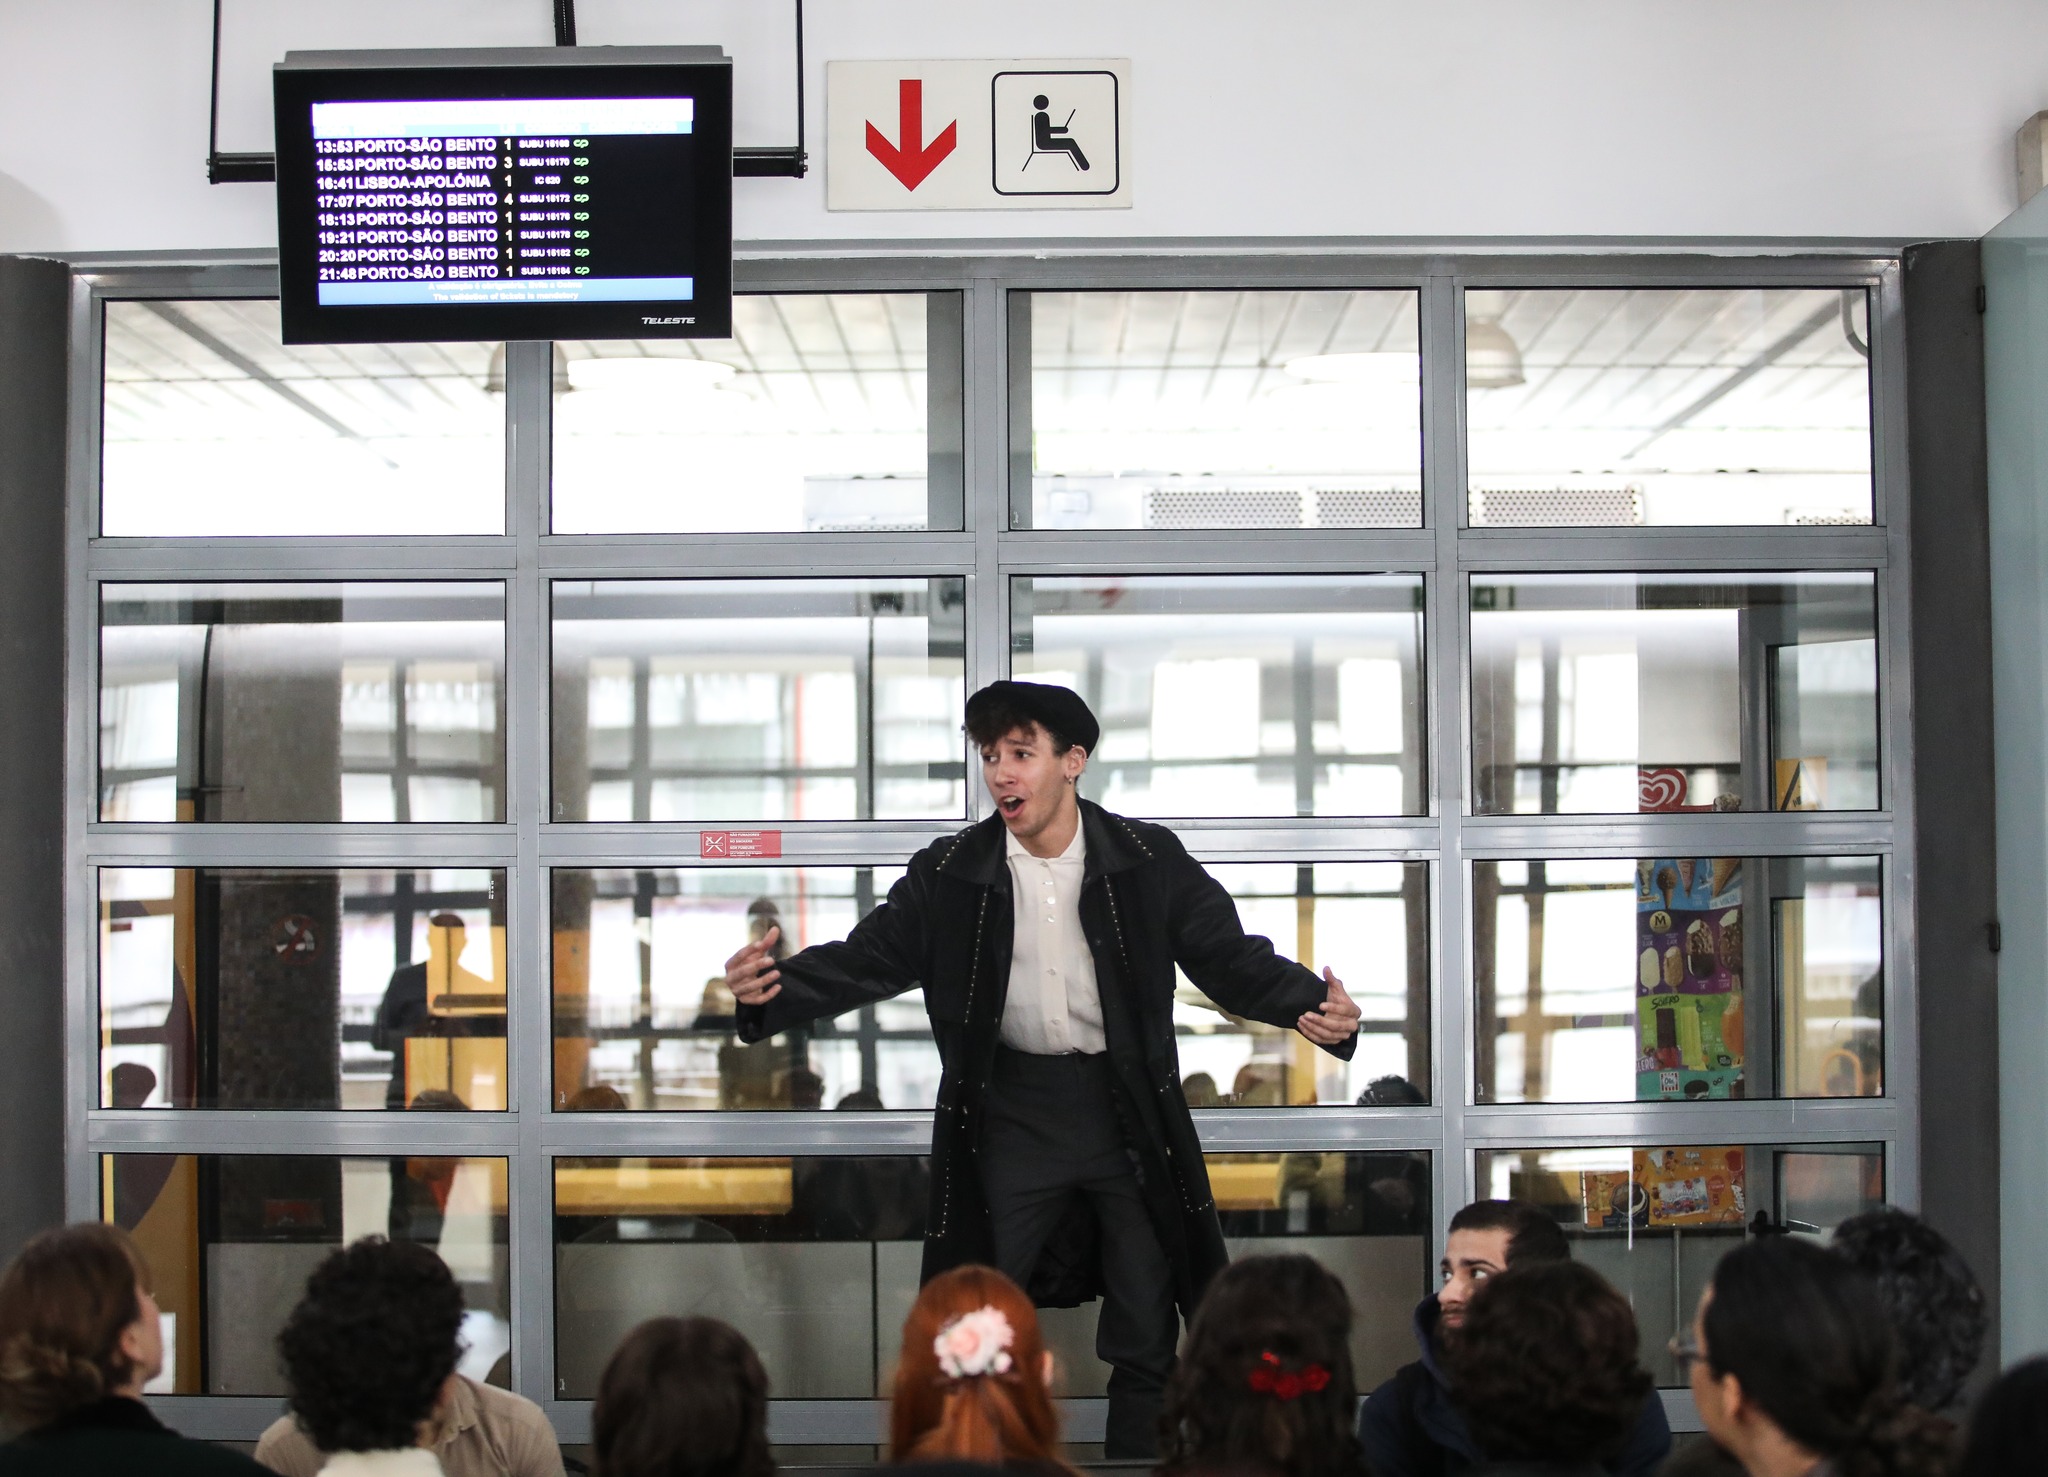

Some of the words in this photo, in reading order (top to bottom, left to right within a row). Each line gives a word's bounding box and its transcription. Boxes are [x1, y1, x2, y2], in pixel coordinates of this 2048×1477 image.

[354, 137, 442, 153] PORTO-SÃO
[445, 138, 497, 152] BENTO
[504, 138, 511, 151] 1
[355, 155, 442, 171] PORTO-SÃO
[446, 157, 497, 170] BENTO
[504, 156, 512, 169] 3
[317, 177, 353, 189] 16:41
[355, 173, 491, 189] LISBOA-APOLÓNIA
[505, 175, 511, 187] 1
[318, 195, 354, 208] 17:07
[355, 192, 443, 208] PORTO-SÃO
[447, 193, 498, 206] BENTO
[504, 193, 513, 205] 4
[319, 213, 355, 226] 18:13
[356, 210, 443, 226] PORTO-SÃO
[447, 211, 498, 224] BENTO
[505, 211, 512, 223] 1
[319, 231, 355, 244] 19:21
[357, 228, 444, 244] PORTO-SÃO
[447, 230, 498, 242] BENTO
[506, 230, 512, 242] 1
[319, 250, 356, 262] 20:20
[357, 246, 444, 262] PORTO-SÃO
[448, 248, 498, 261] BENTO
[506, 248, 512, 260] 1
[320, 268, 357, 280] 21:48
[358, 264, 445, 280] PORTO-SÃO
[448, 266, 499, 279] BENTO
[506, 266, 513, 278] 1
[641, 317, 696, 325] TELESTE
